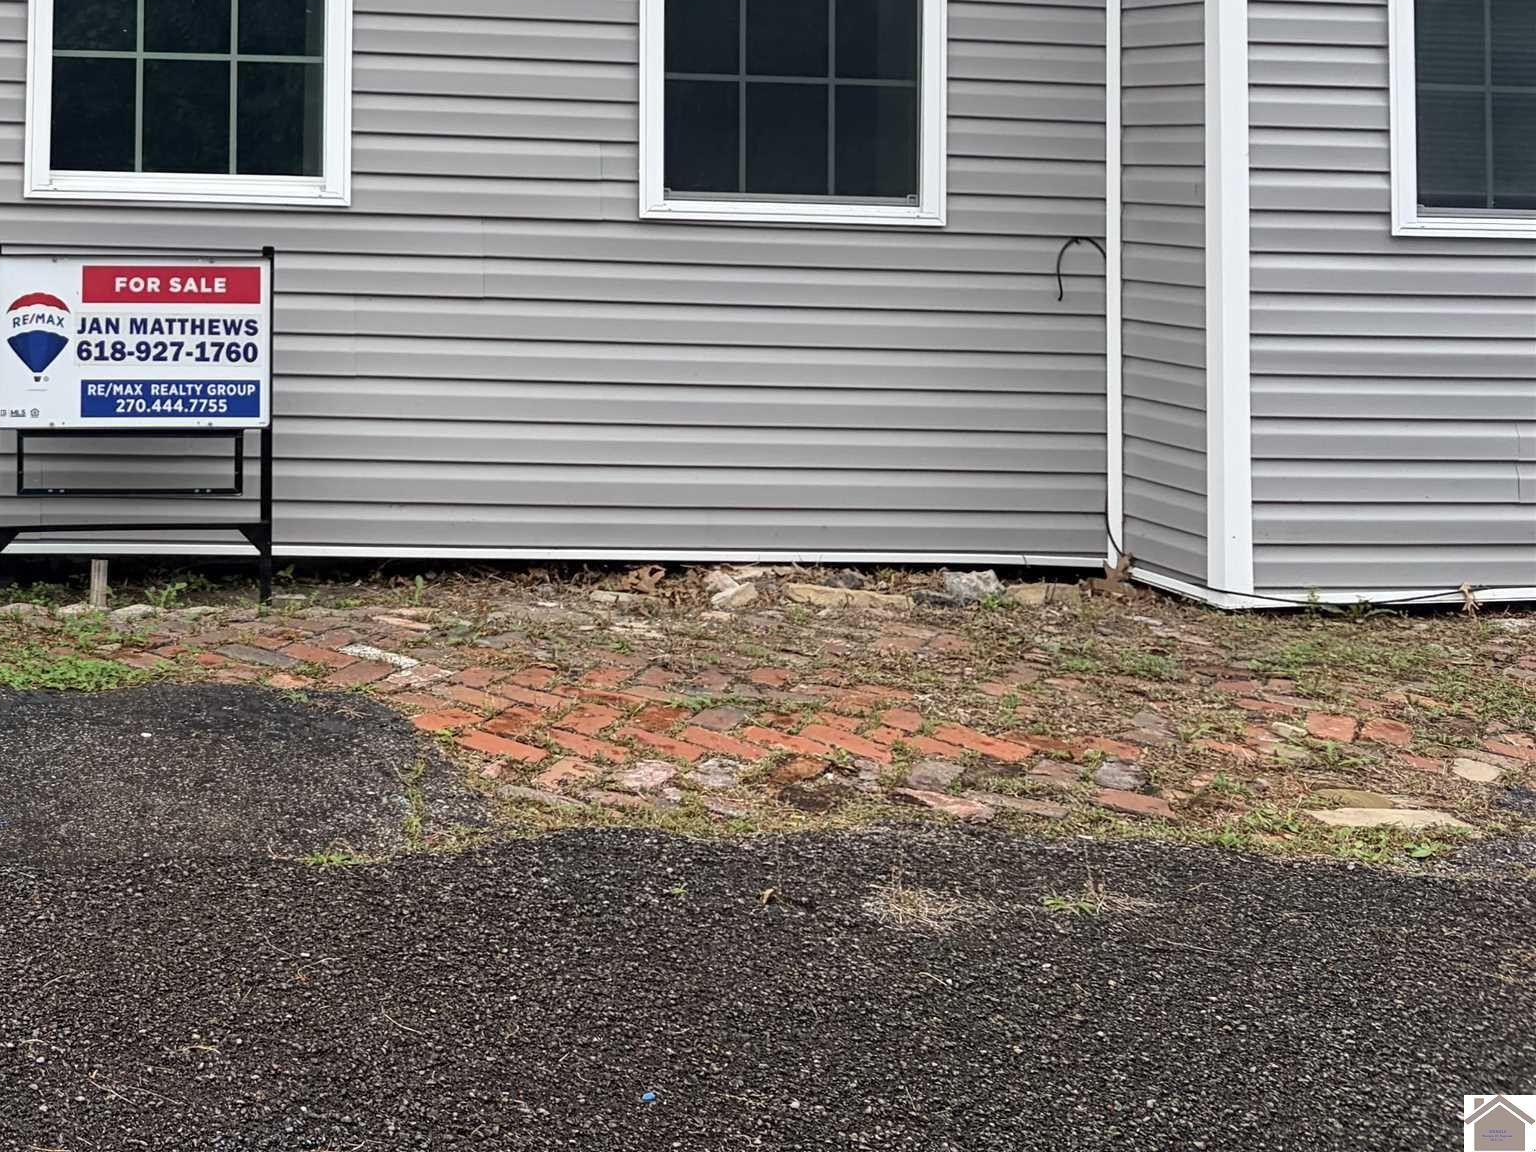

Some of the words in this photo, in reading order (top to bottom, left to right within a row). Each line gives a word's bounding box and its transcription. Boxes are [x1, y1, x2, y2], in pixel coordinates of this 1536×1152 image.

[115, 277, 160, 293] FOR
[169, 277, 227, 293] SALE
[12, 312, 65, 328] RE/MAX
[77, 317, 120, 335] JAN
[129, 318, 259, 336] MATTHEWS
[76, 340, 259, 363] 618-927-1760
[87, 383, 143, 397] RE/MAX
[151, 384, 202, 396] REALTY
[207, 384, 256, 396] GROUP
[116, 399, 228, 413] 270.444.7755
